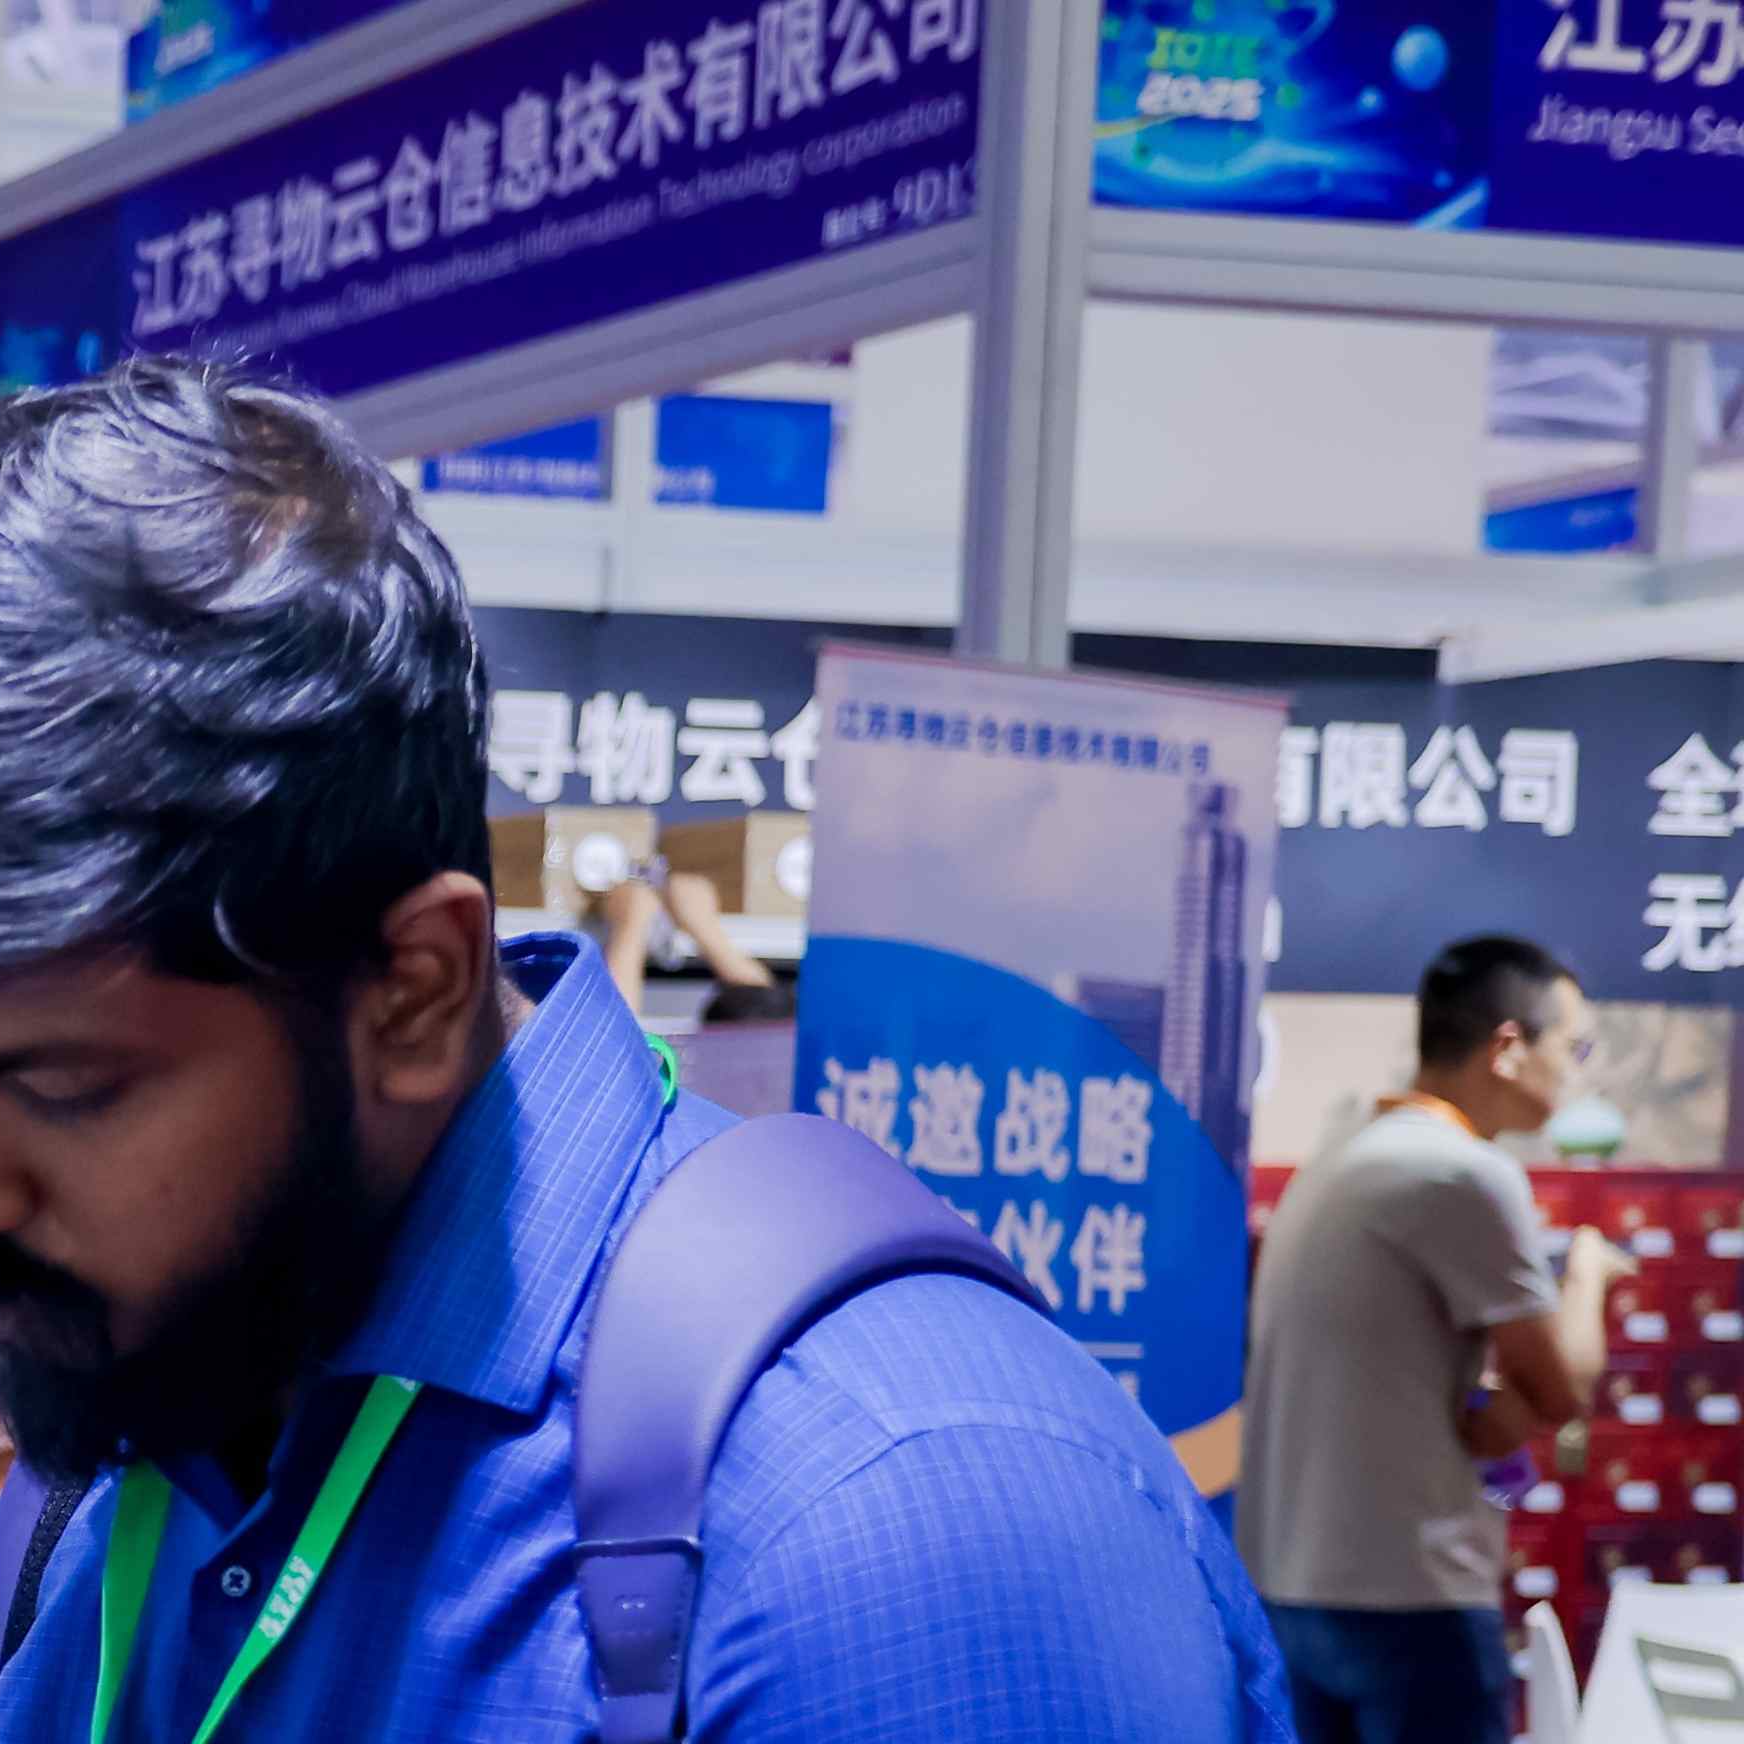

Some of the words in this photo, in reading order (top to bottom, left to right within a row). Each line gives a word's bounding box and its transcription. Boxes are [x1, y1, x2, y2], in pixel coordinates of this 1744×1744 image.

[1137, 70, 1263, 121] 2025
[1526, 93, 1683, 161] Jiangsu
[1688, 105, 1744, 155] Se
[132, 0, 977, 336] 江苏寻物云仓信息技术有限公司
[658, 152, 800, 222] Technology
[802, 94, 967, 174] corporation
[1646, 732, 1744, 838] 全
[1642, 873, 1744, 972] 无
[816, 1056, 1153, 1183] 诚邀战略
[962, 1198, 1146, 1316] 伙伴
